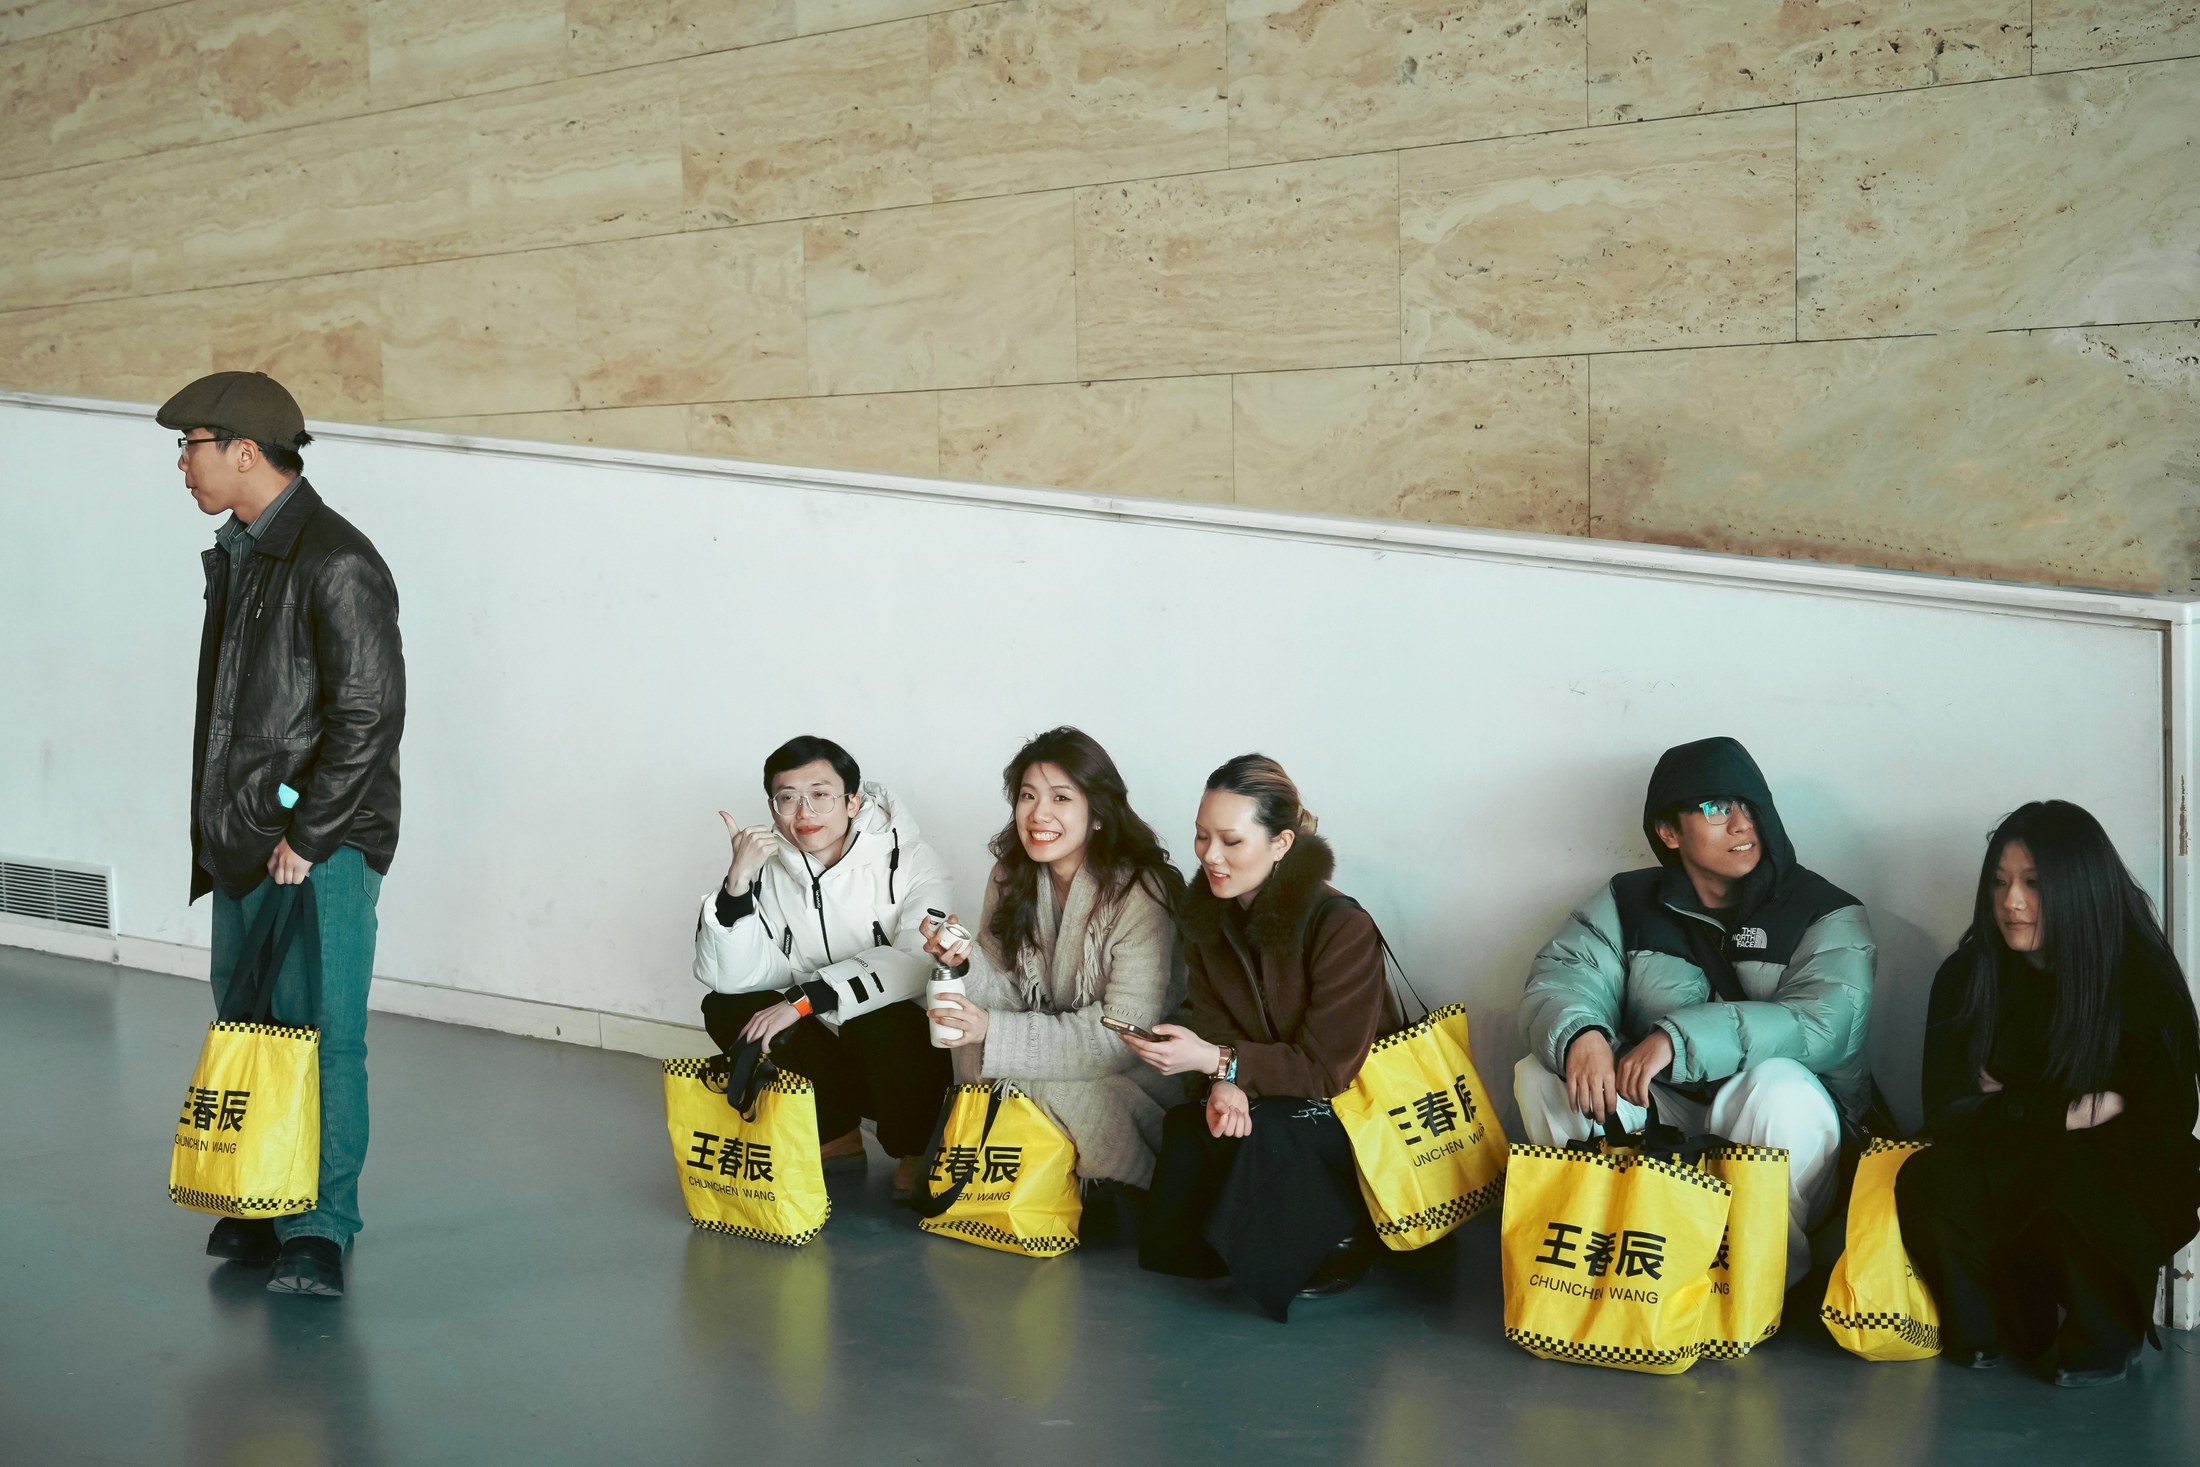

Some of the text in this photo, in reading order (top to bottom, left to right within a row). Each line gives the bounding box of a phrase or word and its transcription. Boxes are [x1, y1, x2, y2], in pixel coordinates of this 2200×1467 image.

[1732, 934, 1756, 942] NORTH
[1742, 926, 1757, 935] THE
[212, 1141, 237, 1154] WANG
[686, 1130, 775, 1182] 王春辰
[1412, 1138, 1464, 1167] UNCHEN
[688, 1175, 776, 1202] CHUNCHEN WANG
[976, 1191, 1011, 1201] WANG
[1534, 1222, 1667, 1281] 王春辰
[1529, 1274, 1659, 1304] CHUNCHEN WANG
